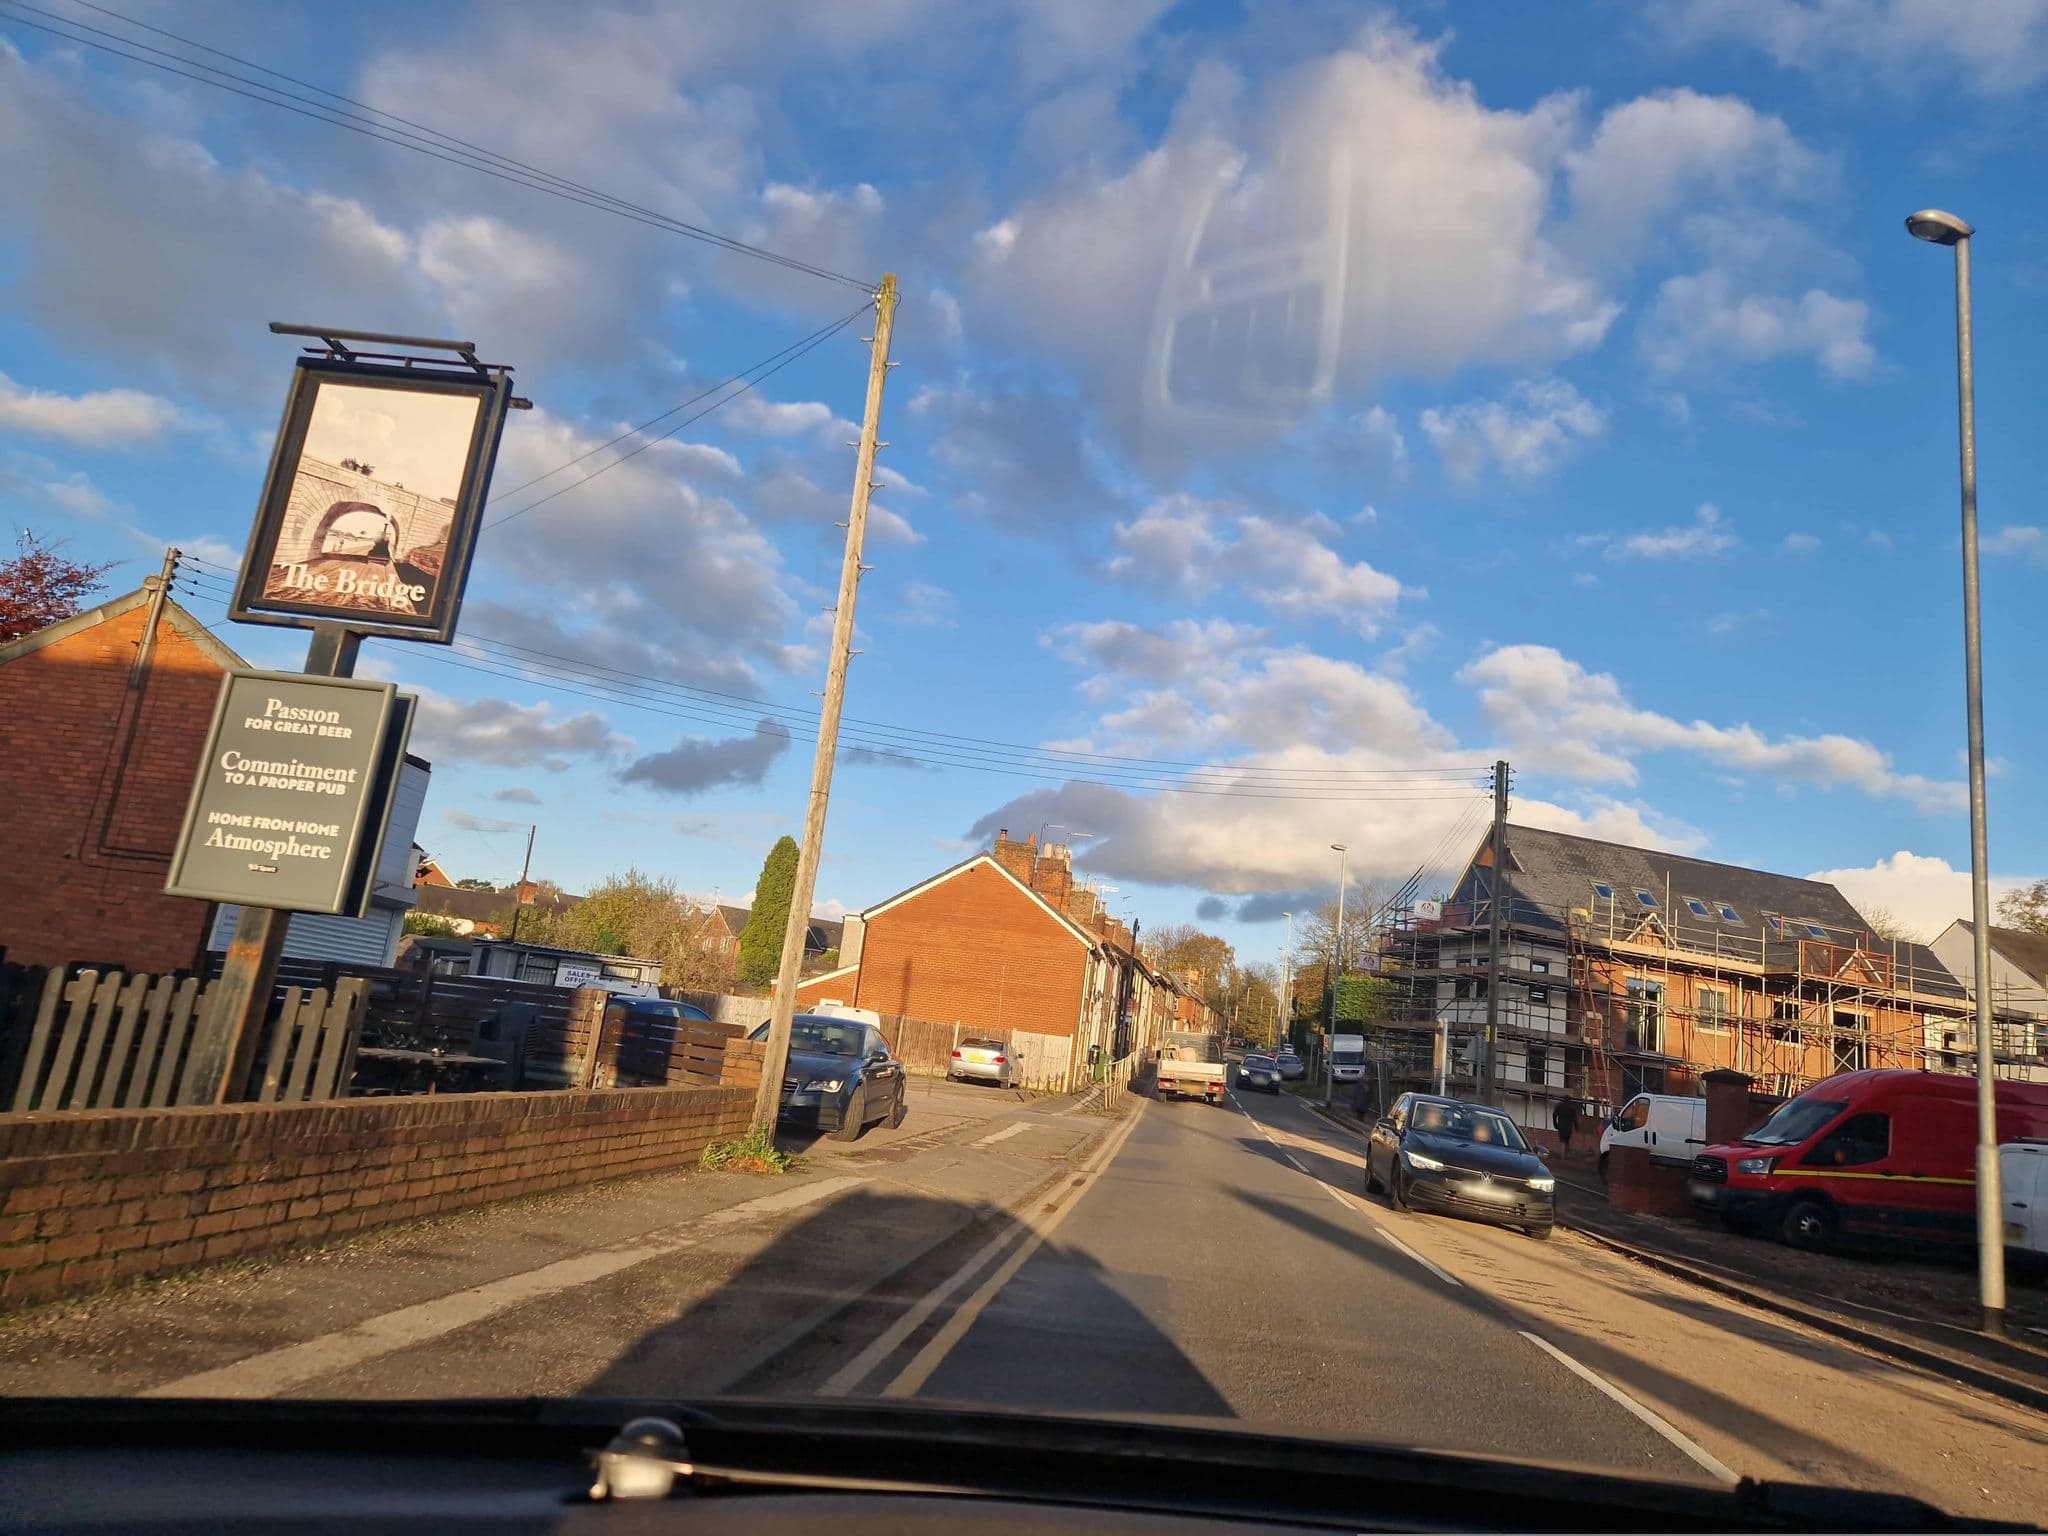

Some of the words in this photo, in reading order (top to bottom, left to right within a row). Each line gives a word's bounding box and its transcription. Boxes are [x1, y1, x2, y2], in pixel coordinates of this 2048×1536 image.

[280, 563, 328, 591] The
[335, 569, 426, 608] Bridge
[264, 698, 339, 724] Passion
[245, 718, 272, 731] FOR
[273, 721, 317, 736] GREAT
[318, 726, 352, 739] BEER
[220, 751, 358, 783] Commitment
[224, 772, 244, 785] TO
[245, 775, 257, 786] A
[258, 776, 314, 793] PROPER
[316, 782, 346, 796] PUB
[207, 812, 252, 827] HOME
[253, 815, 295, 832] FROM
[295, 820, 340, 837] HOME
[204, 827, 332, 861] Atmosphere
[567, 970, 590, 978] SALES
